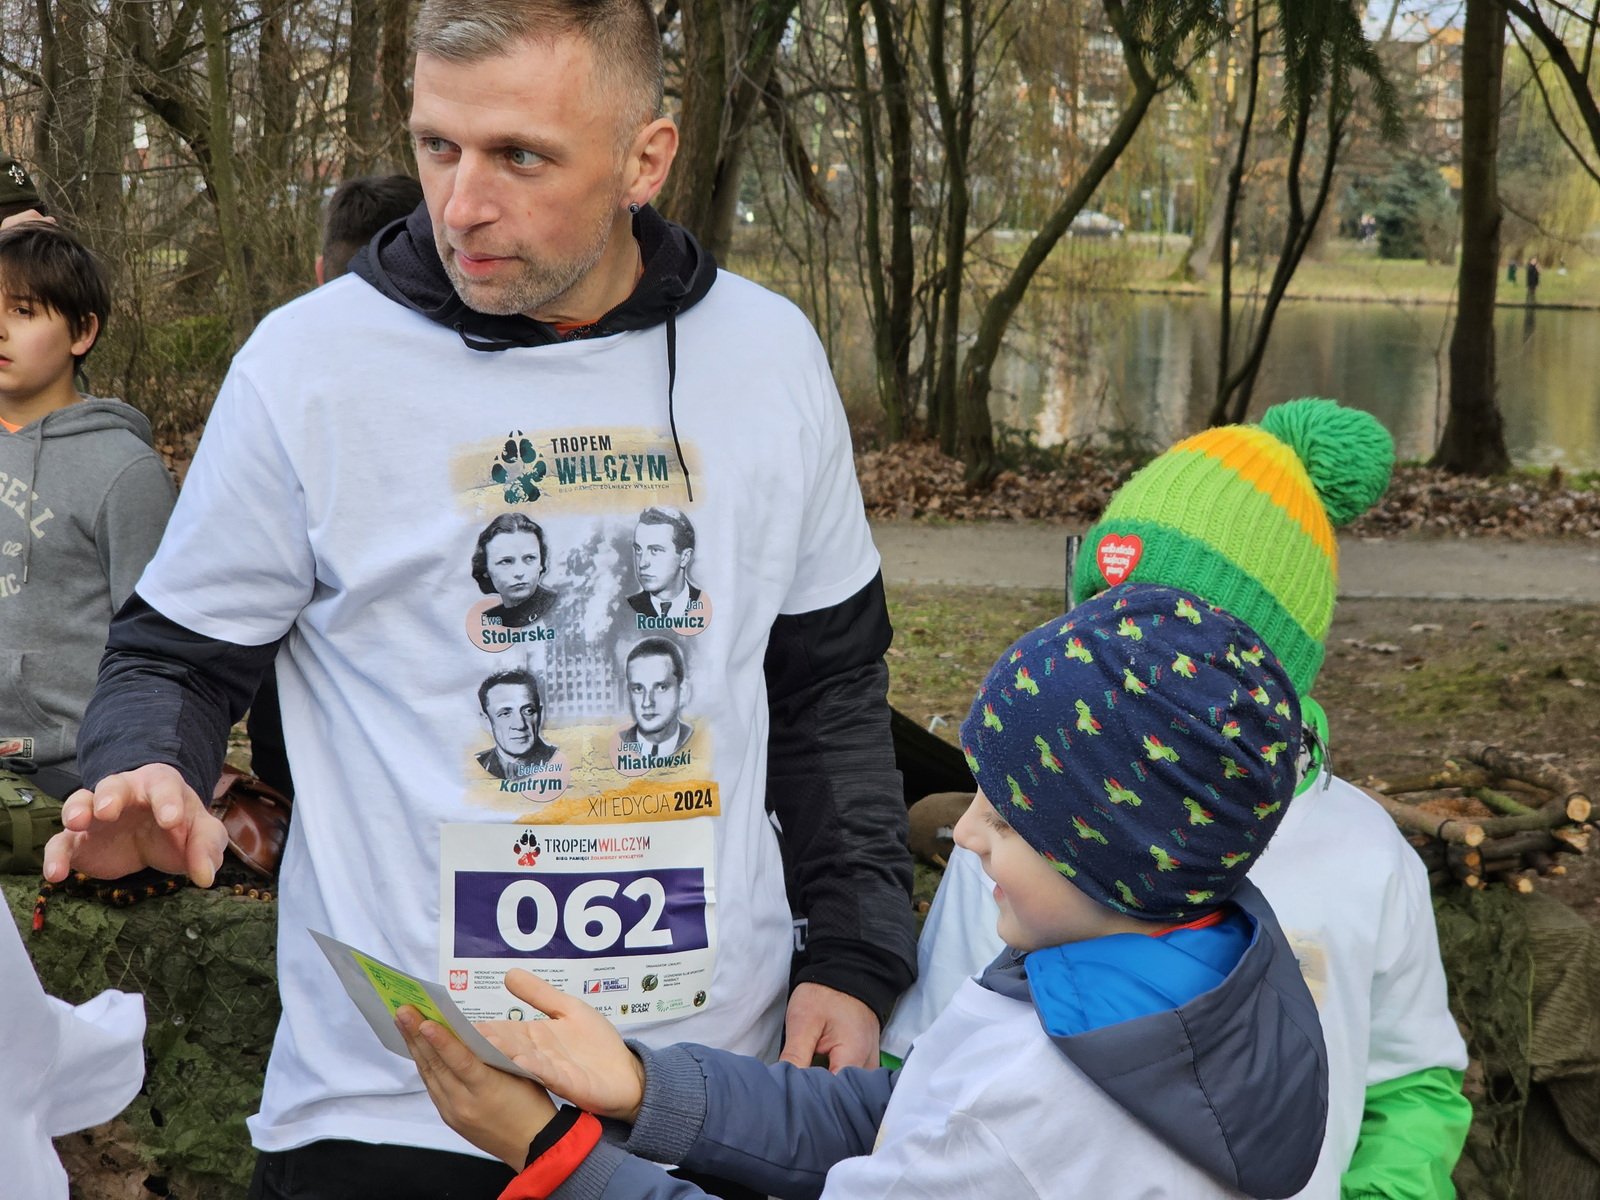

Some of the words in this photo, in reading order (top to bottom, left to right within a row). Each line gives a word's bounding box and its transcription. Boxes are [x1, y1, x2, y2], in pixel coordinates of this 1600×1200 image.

[550, 435, 612, 454] TROPEM
[555, 454, 669, 485] WILCZYM
[687, 597, 703, 610] Jan
[481, 614, 503, 626] Ewa
[637, 611, 704, 629] Rodowicz
[481, 625, 555, 645] Stolarska
[618, 741, 643, 753] Jerzy
[518, 760, 563, 777] Bolesław
[618, 749, 691, 770] Miatkowski
[500, 778, 562, 794] Kontrym
[587, 799, 607, 818] XII
[613, 795, 670, 817] EDYCJA
[674, 788, 713, 812] 2024
[496, 877, 674, 952] 062
